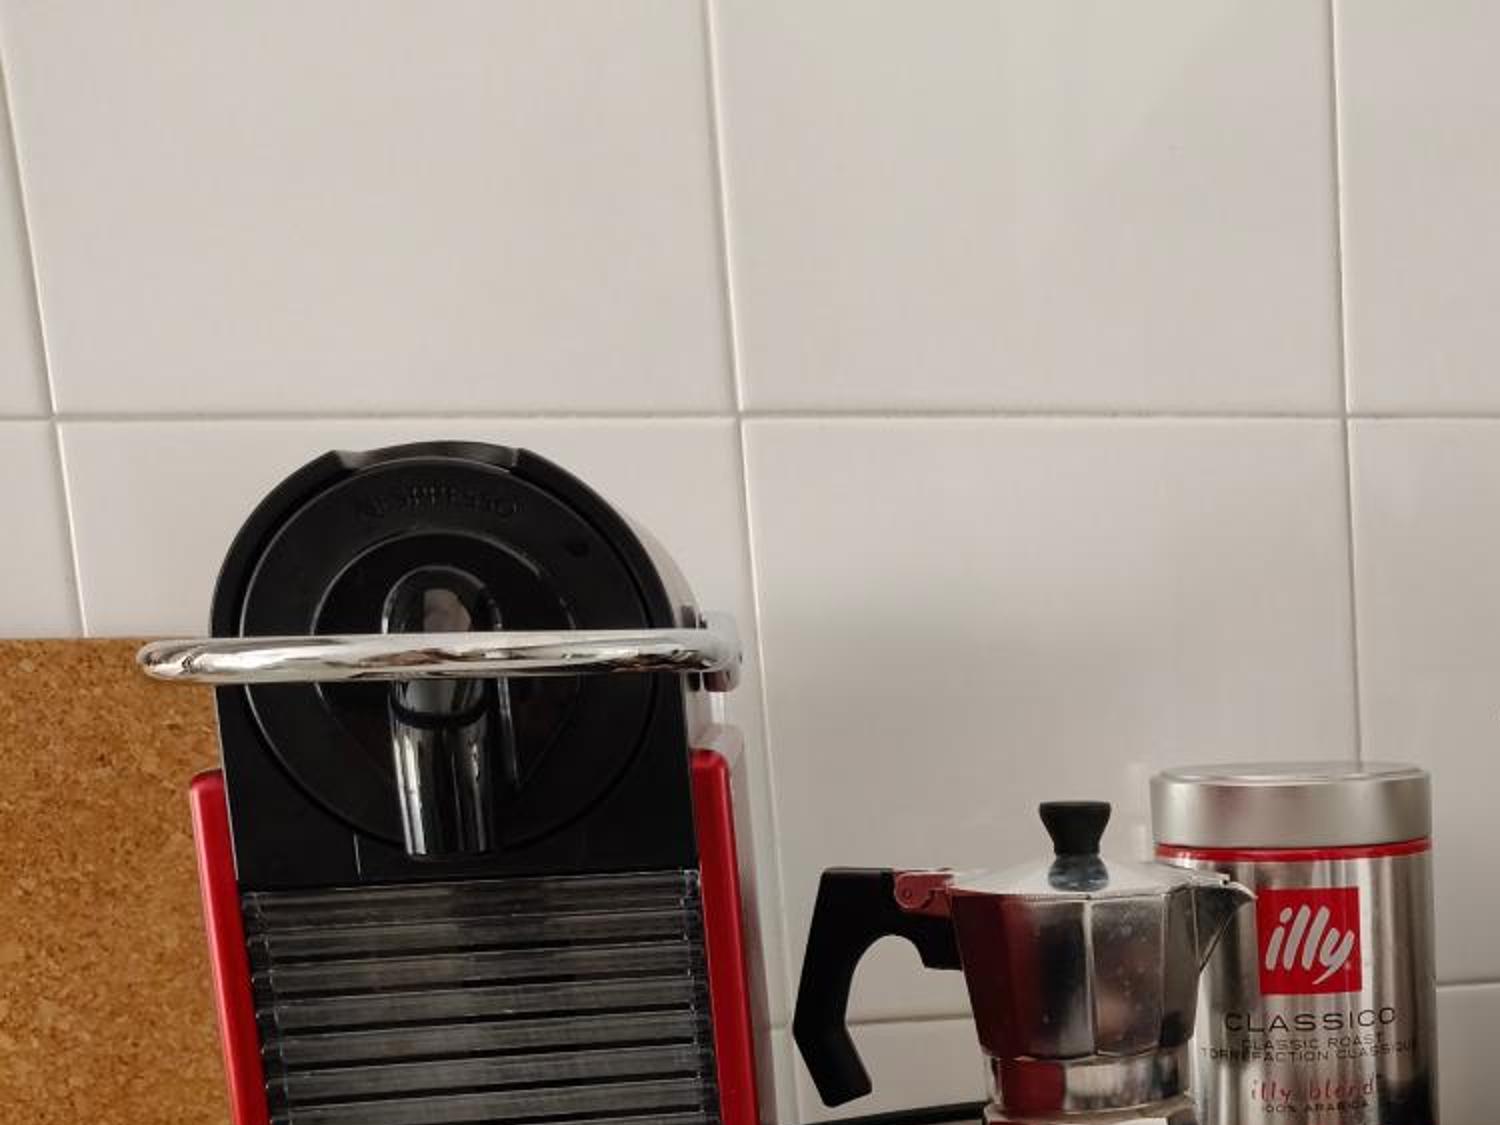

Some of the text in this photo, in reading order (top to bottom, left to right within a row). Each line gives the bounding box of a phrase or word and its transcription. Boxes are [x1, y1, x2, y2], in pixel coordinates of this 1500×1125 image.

[1264, 904, 1355, 985] illy
[1224, 1006, 1397, 1033] CLASSICO
[1241, 1031, 1384, 1051] CLASSIC ROAST
[1251, 1079, 1294, 1103] illy
